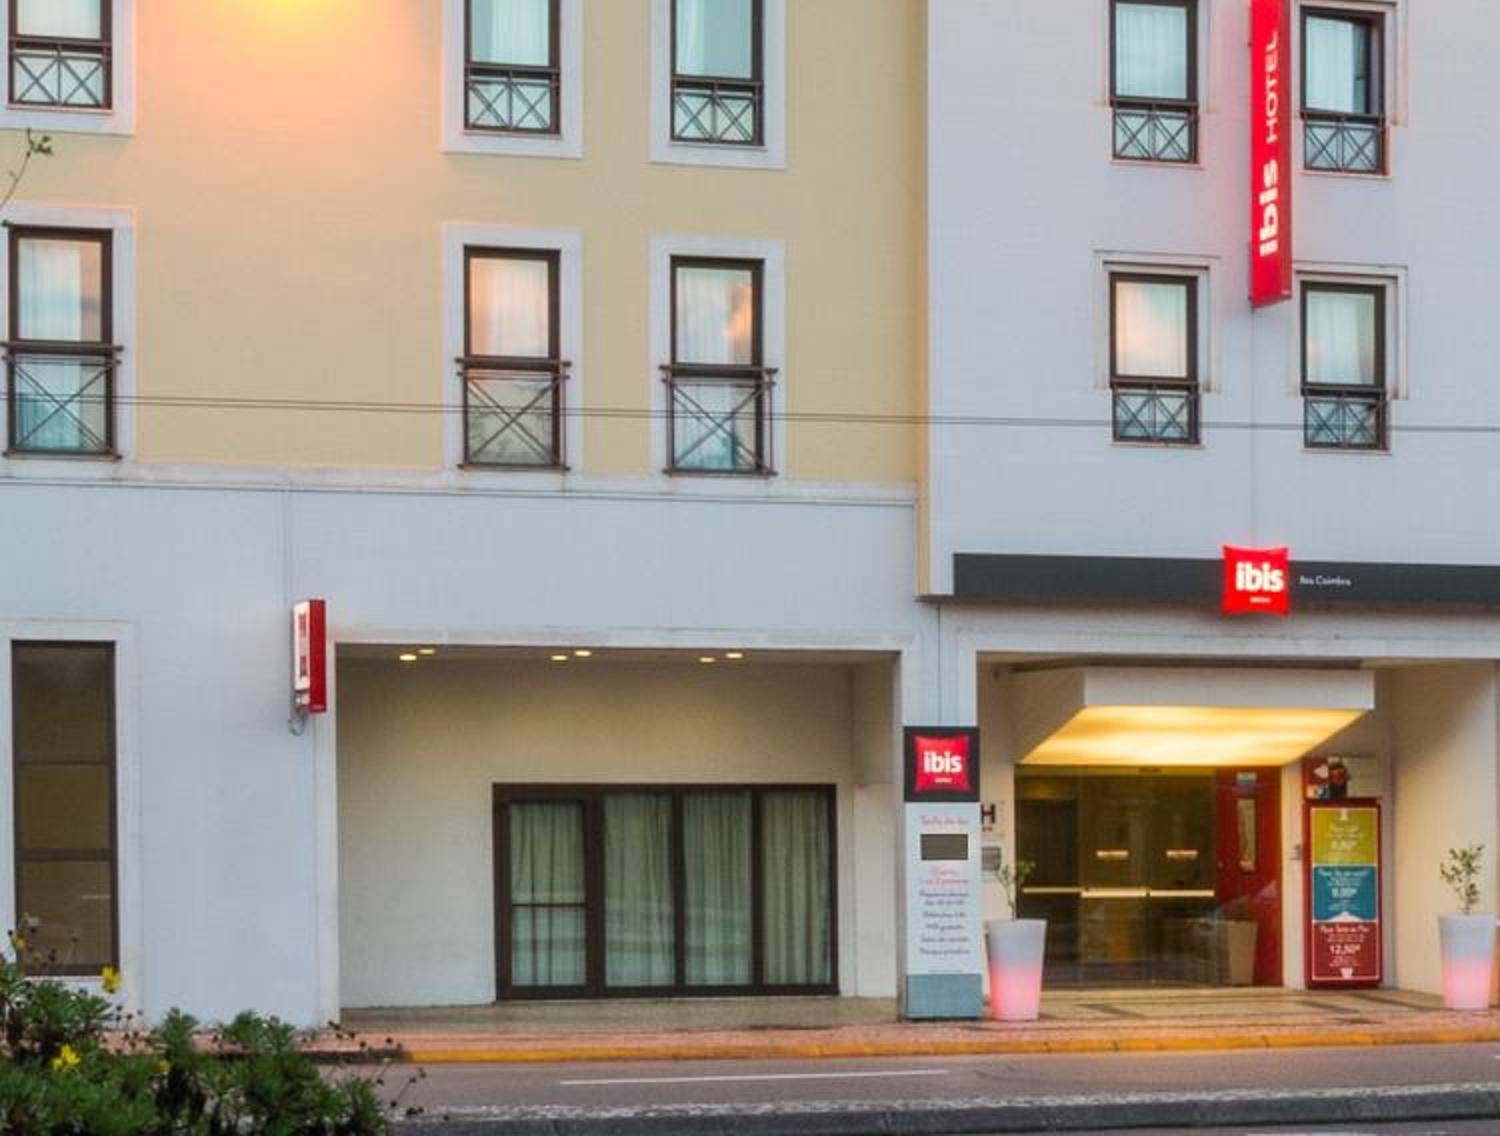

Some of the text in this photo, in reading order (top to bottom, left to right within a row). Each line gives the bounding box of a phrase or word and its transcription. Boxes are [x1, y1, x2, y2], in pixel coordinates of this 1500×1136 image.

[1259, 30, 1279, 257] ibis HOTEL
[1235, 561, 1284, 592] ibis
[923, 751, 963, 774] ibis
